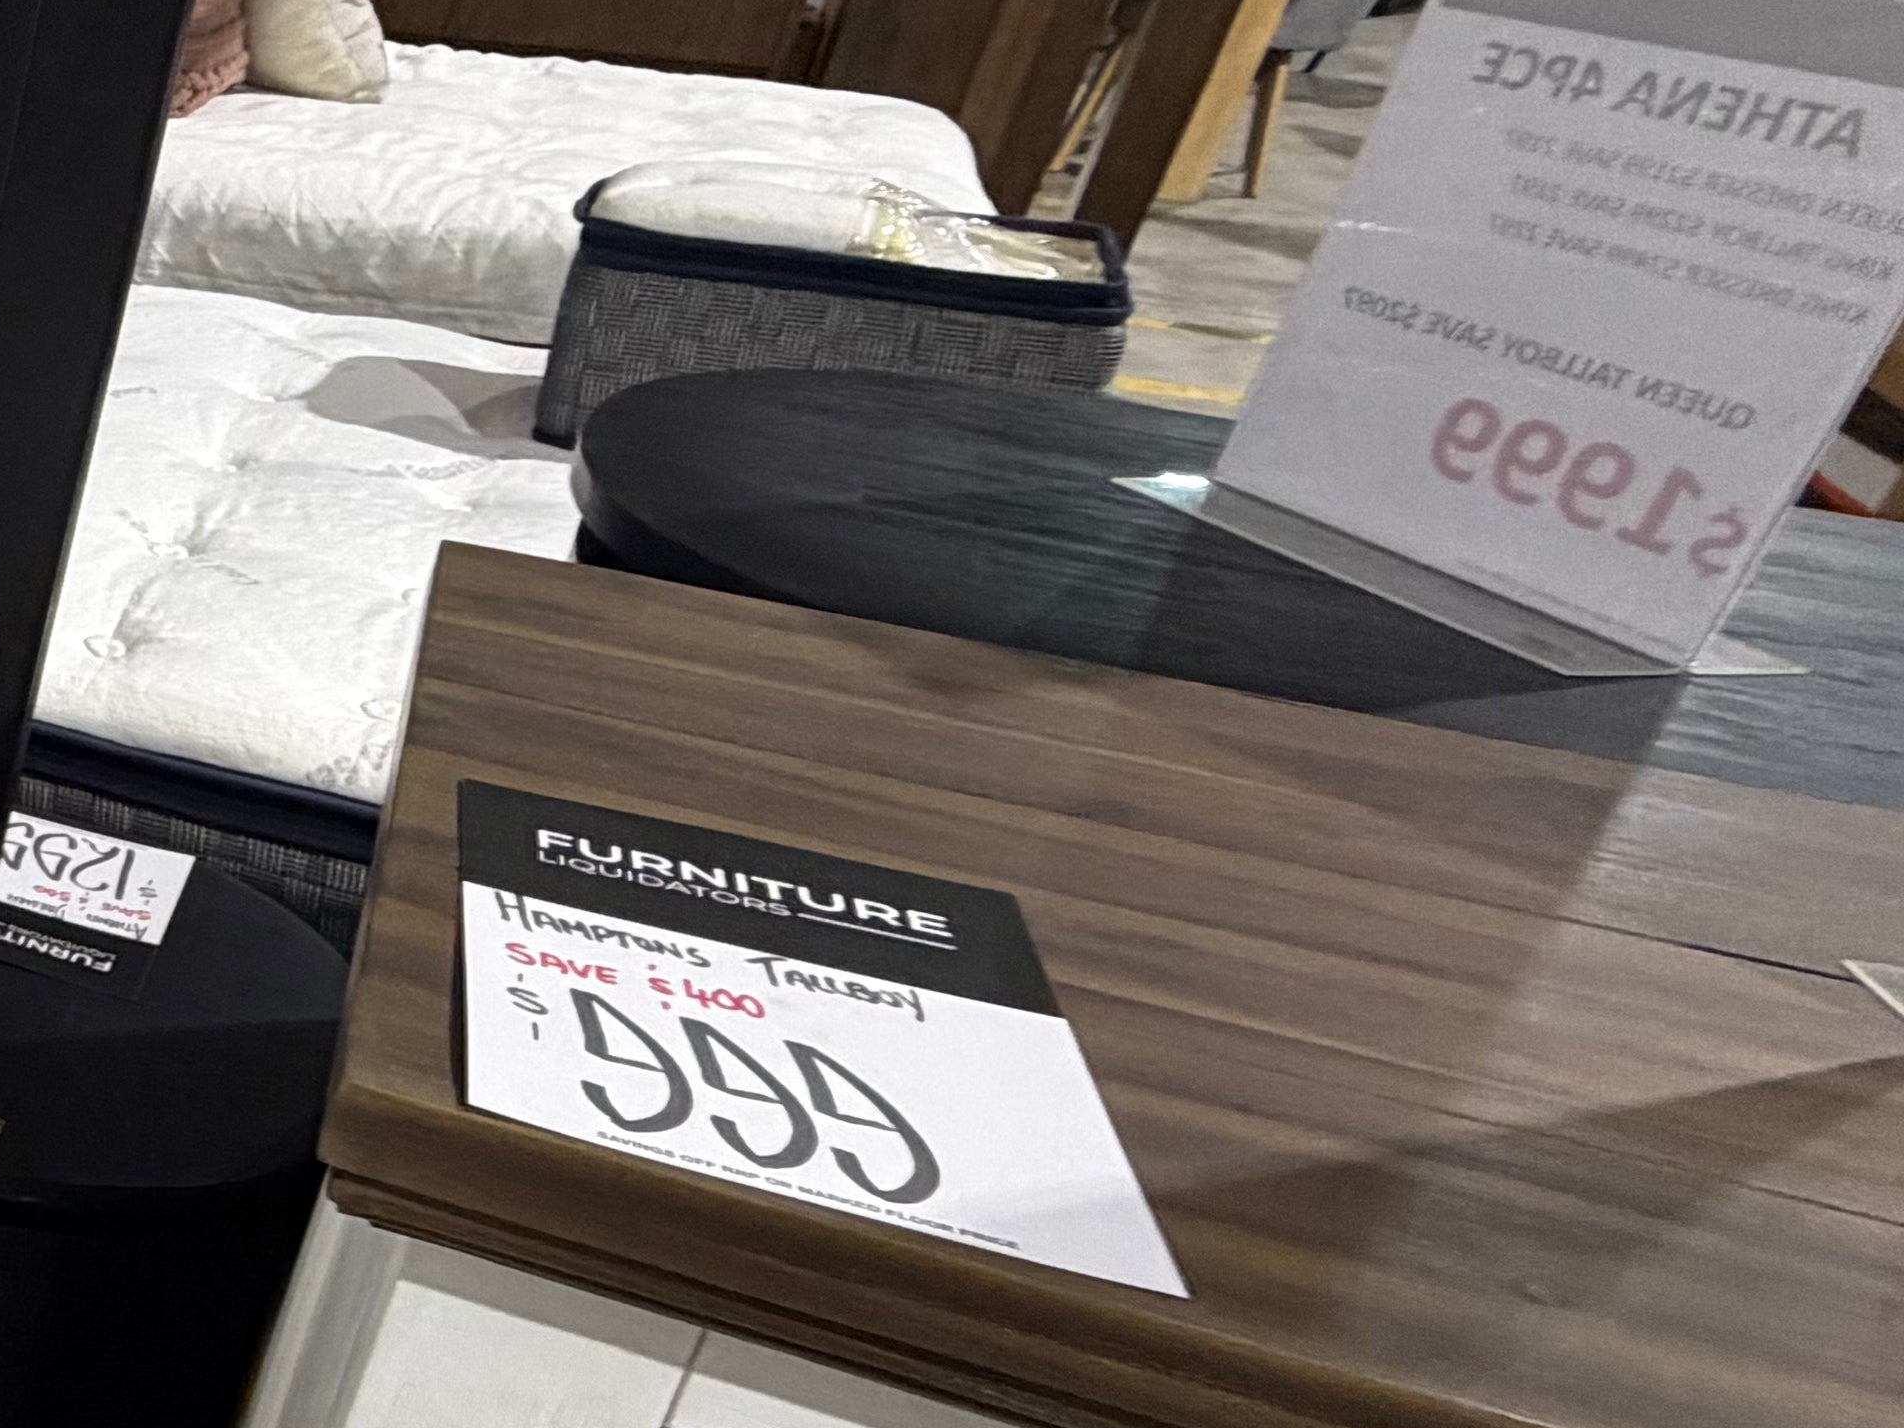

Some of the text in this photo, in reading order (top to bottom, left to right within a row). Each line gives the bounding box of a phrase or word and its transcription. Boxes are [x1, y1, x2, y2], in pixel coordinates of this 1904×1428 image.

[536, 828, 955, 938] FURNITURE
[536, 849, 792, 917] LIQUIDATORS
[494, 890, 925, 1022] HAMPTONS TALLBOY
[504, 942, 619, 985] SAVE
[596, 1130, 1021, 1250] SAVINGS OFF RRP OR MARKED FLOOR PRICE
